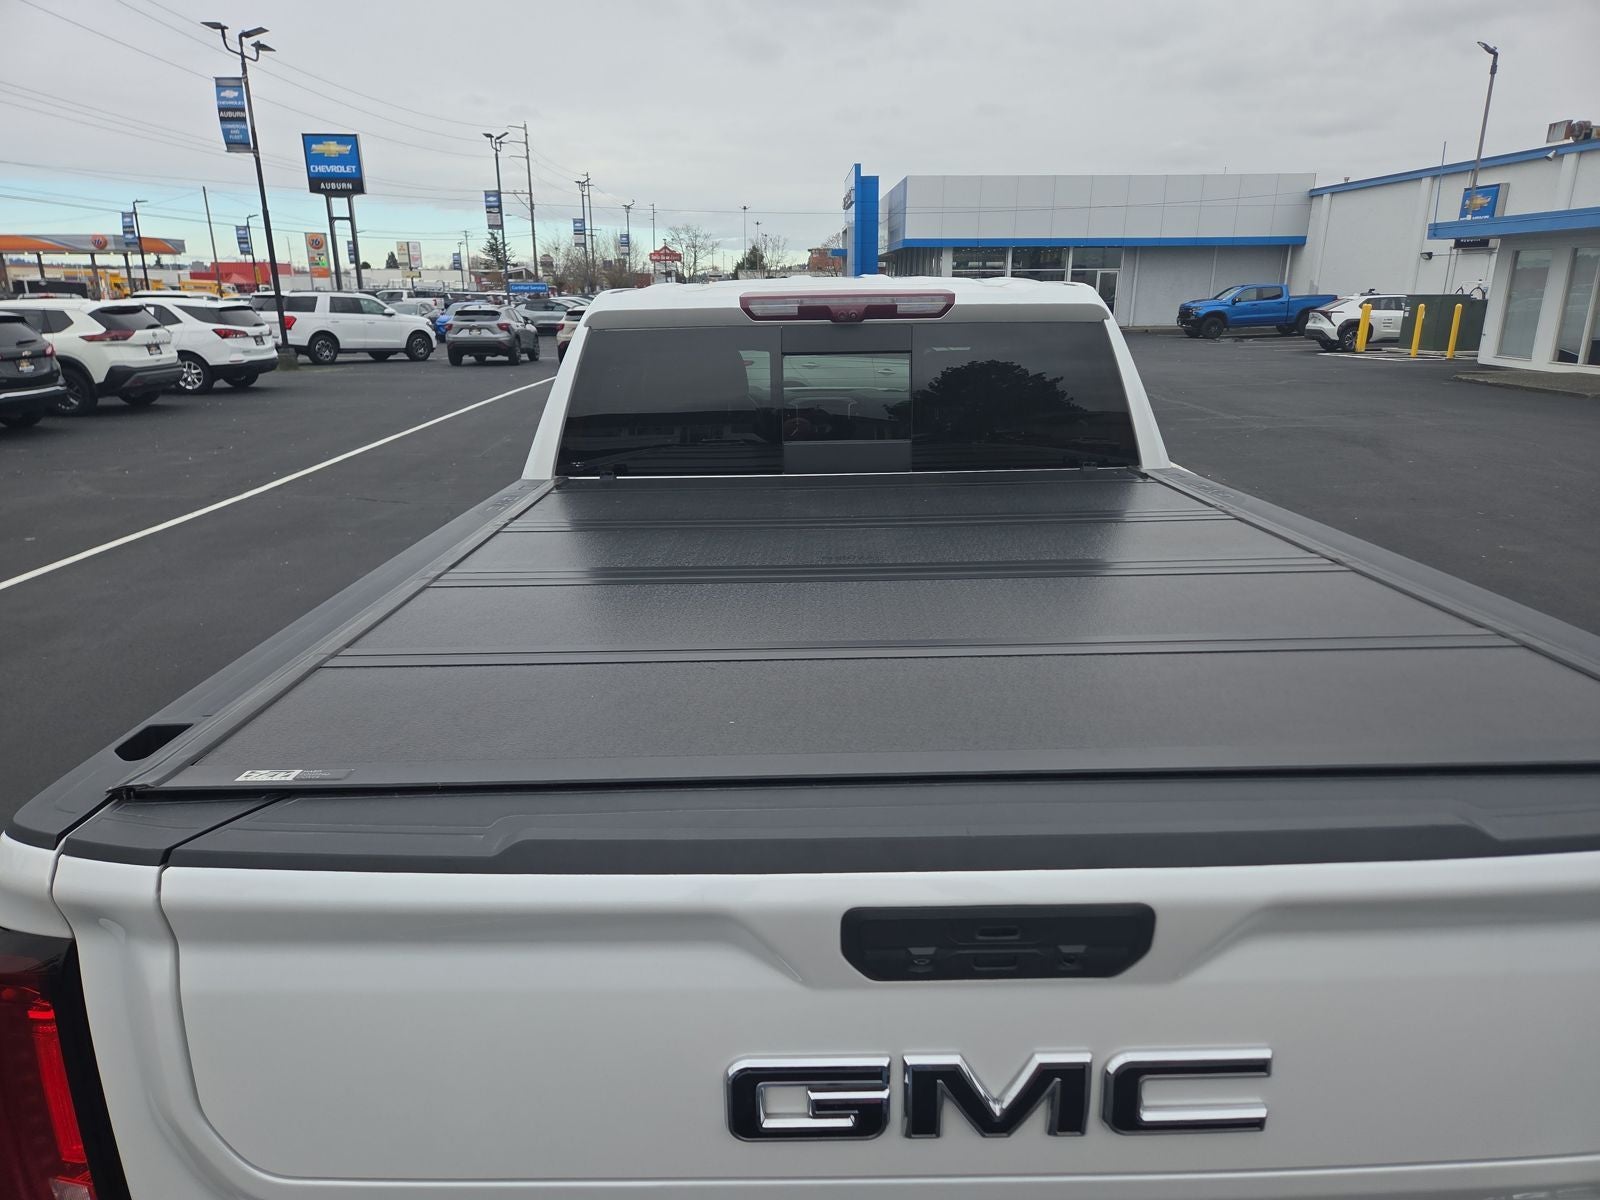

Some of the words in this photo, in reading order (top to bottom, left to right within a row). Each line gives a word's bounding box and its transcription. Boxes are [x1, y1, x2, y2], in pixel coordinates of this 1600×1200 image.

[310, 165, 356, 173] CHEVROLET
[320, 182, 353, 190] AUBURN
[726, 1047, 1273, 1142] GMC
